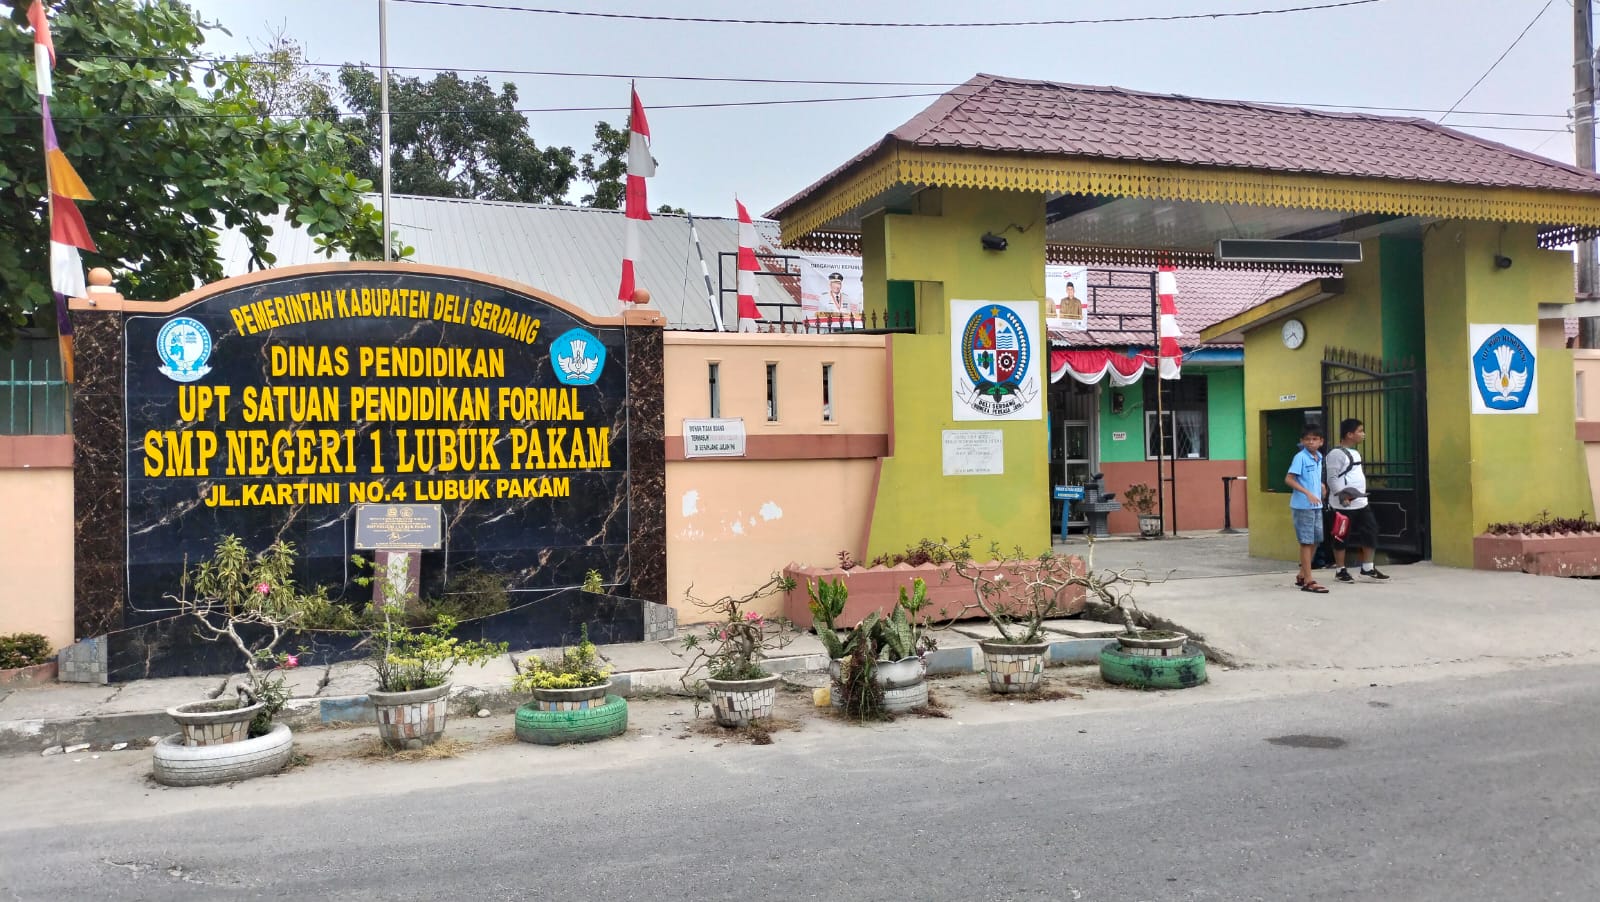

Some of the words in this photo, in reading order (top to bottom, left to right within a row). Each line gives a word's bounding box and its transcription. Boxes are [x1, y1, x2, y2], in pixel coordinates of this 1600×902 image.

[229, 289, 335, 337] PEMERINTAH
[336, 287, 431, 319] KABUPATEN
[432, 292, 470, 325] DELI
[470, 299, 541, 345] SERDANG
[271, 345, 350, 377] DINAS
[359, 346, 505, 378] PENDIDIKAN
[178, 385, 231, 422] UPT
[242, 385, 340, 423] SATUAN
[350, 386, 490, 422] PENDIDIKAN
[498, 386, 585, 421] FORMAL
[978, 399, 991, 408] DELI
[992, 399, 1016, 409] SERDANG
[143, 429, 218, 478] SMP
[225, 428, 357, 477] NEGERI
[369, 428, 385, 474] 1
[395, 427, 501, 473] LUBUK
[509, 426, 612, 470] PAKAM
[204, 482, 340, 508] JL.KARTINI
[349, 480, 408, 504] NO.4
[414, 478, 491, 502] LUBUK
[496, 476, 570, 499] PAKAM
